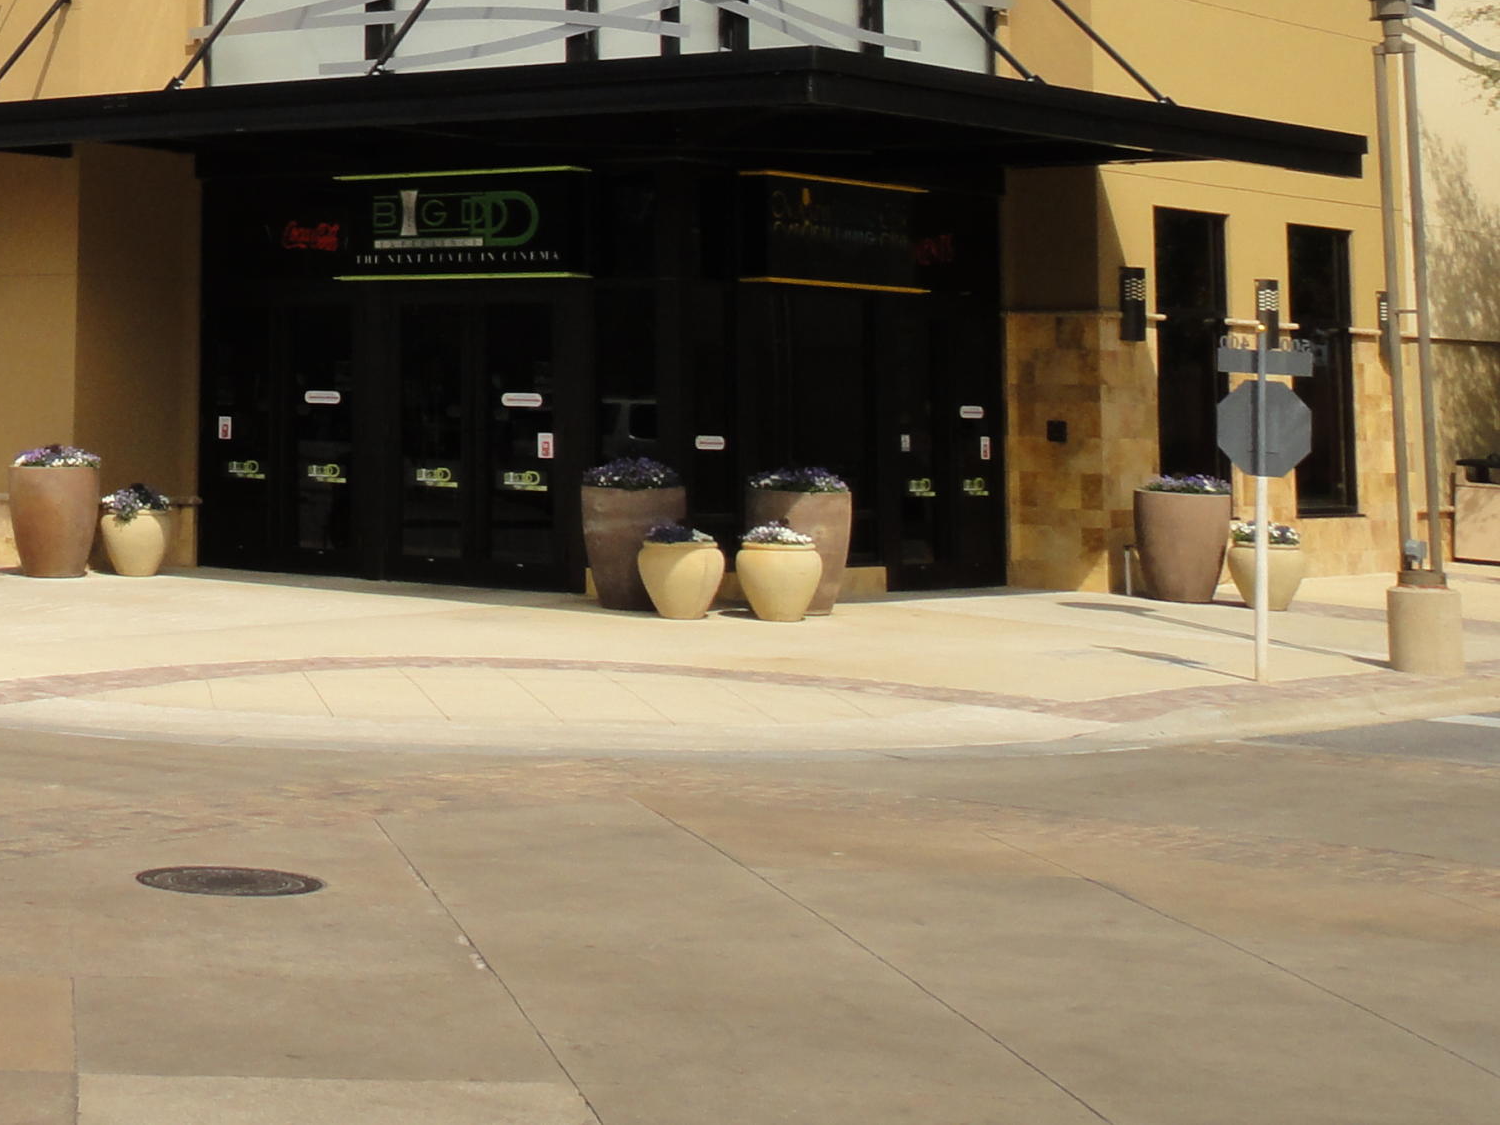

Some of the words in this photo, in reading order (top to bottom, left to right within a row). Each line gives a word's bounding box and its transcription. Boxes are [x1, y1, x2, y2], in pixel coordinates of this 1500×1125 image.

[372, 189, 448, 237] BIG
[356, 254, 380, 265] THE
[388, 254, 423, 264] NEXT
[429, 252, 476, 263] LEVEL
[480, 252, 494, 262] IN
[502, 250, 560, 261] CINEMA
